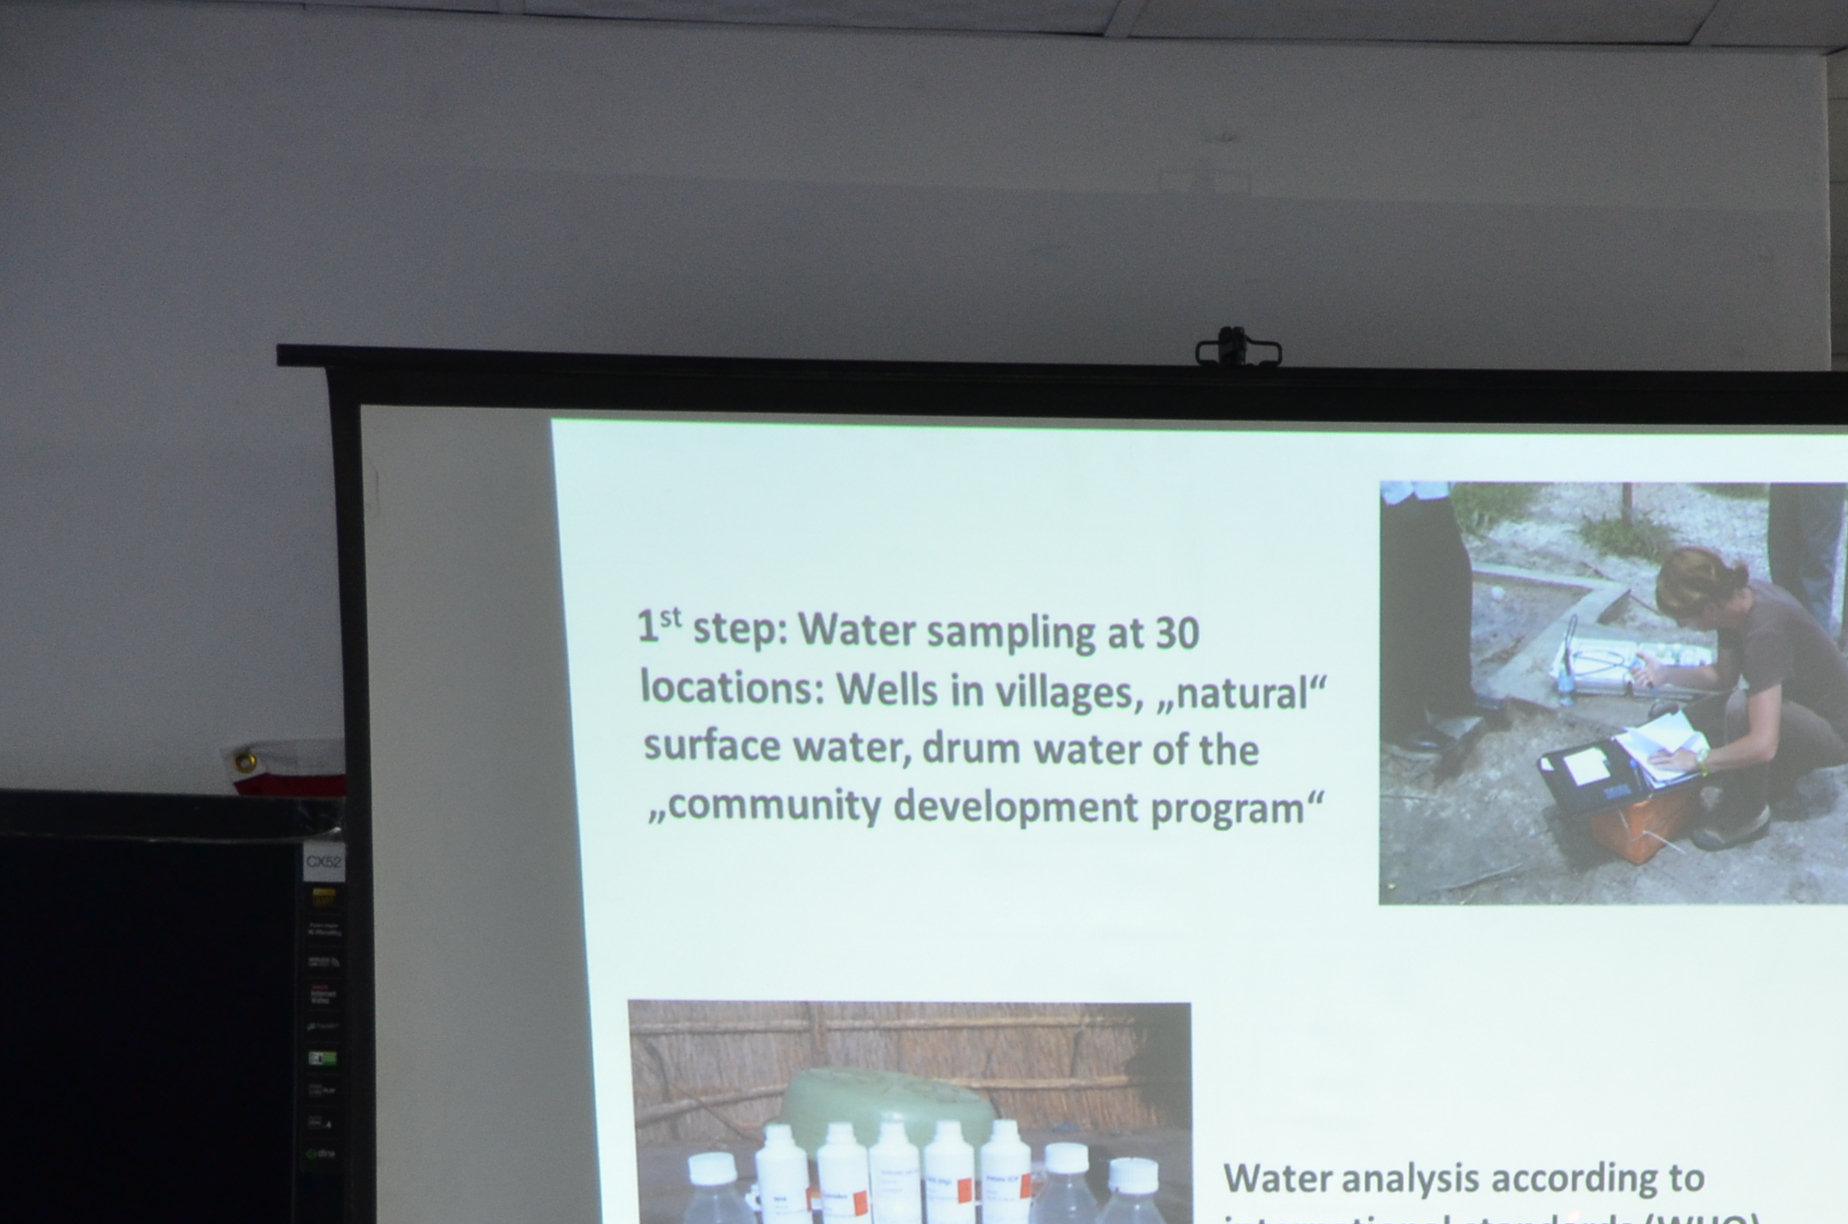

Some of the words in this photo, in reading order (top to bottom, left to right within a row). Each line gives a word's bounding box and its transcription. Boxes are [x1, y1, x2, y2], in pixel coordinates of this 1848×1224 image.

[693, 612, 787, 653] step:
[797, 611, 917, 647] Water
[927, 612, 1096, 657] sampling
[1108, 618, 1145, 649] at
[1156, 615, 1200, 650] 30
[640, 666, 824, 705] locations:
[835, 670, 938, 707] Wells
[951, 672, 984, 707] in
[995, 672, 1144, 717] villages,
[644, 725, 781, 762] surface
[792, 732, 912, 770] water,
[922, 728, 1020, 764] drum
[1033, 735, 1143, 766] water
[1152, 731, 1190, 766] of
[1198, 731, 1260, 767] the
[894, 787, 1139, 830] development
[306, 855, 341, 868] CX52
[1223, 1163, 1334, 1193] Water
[1342, 1161, 1480, 1200] analysis
[1492, 1160, 1659, 1200] according
[1668, 1164, 1705, 1192] to
